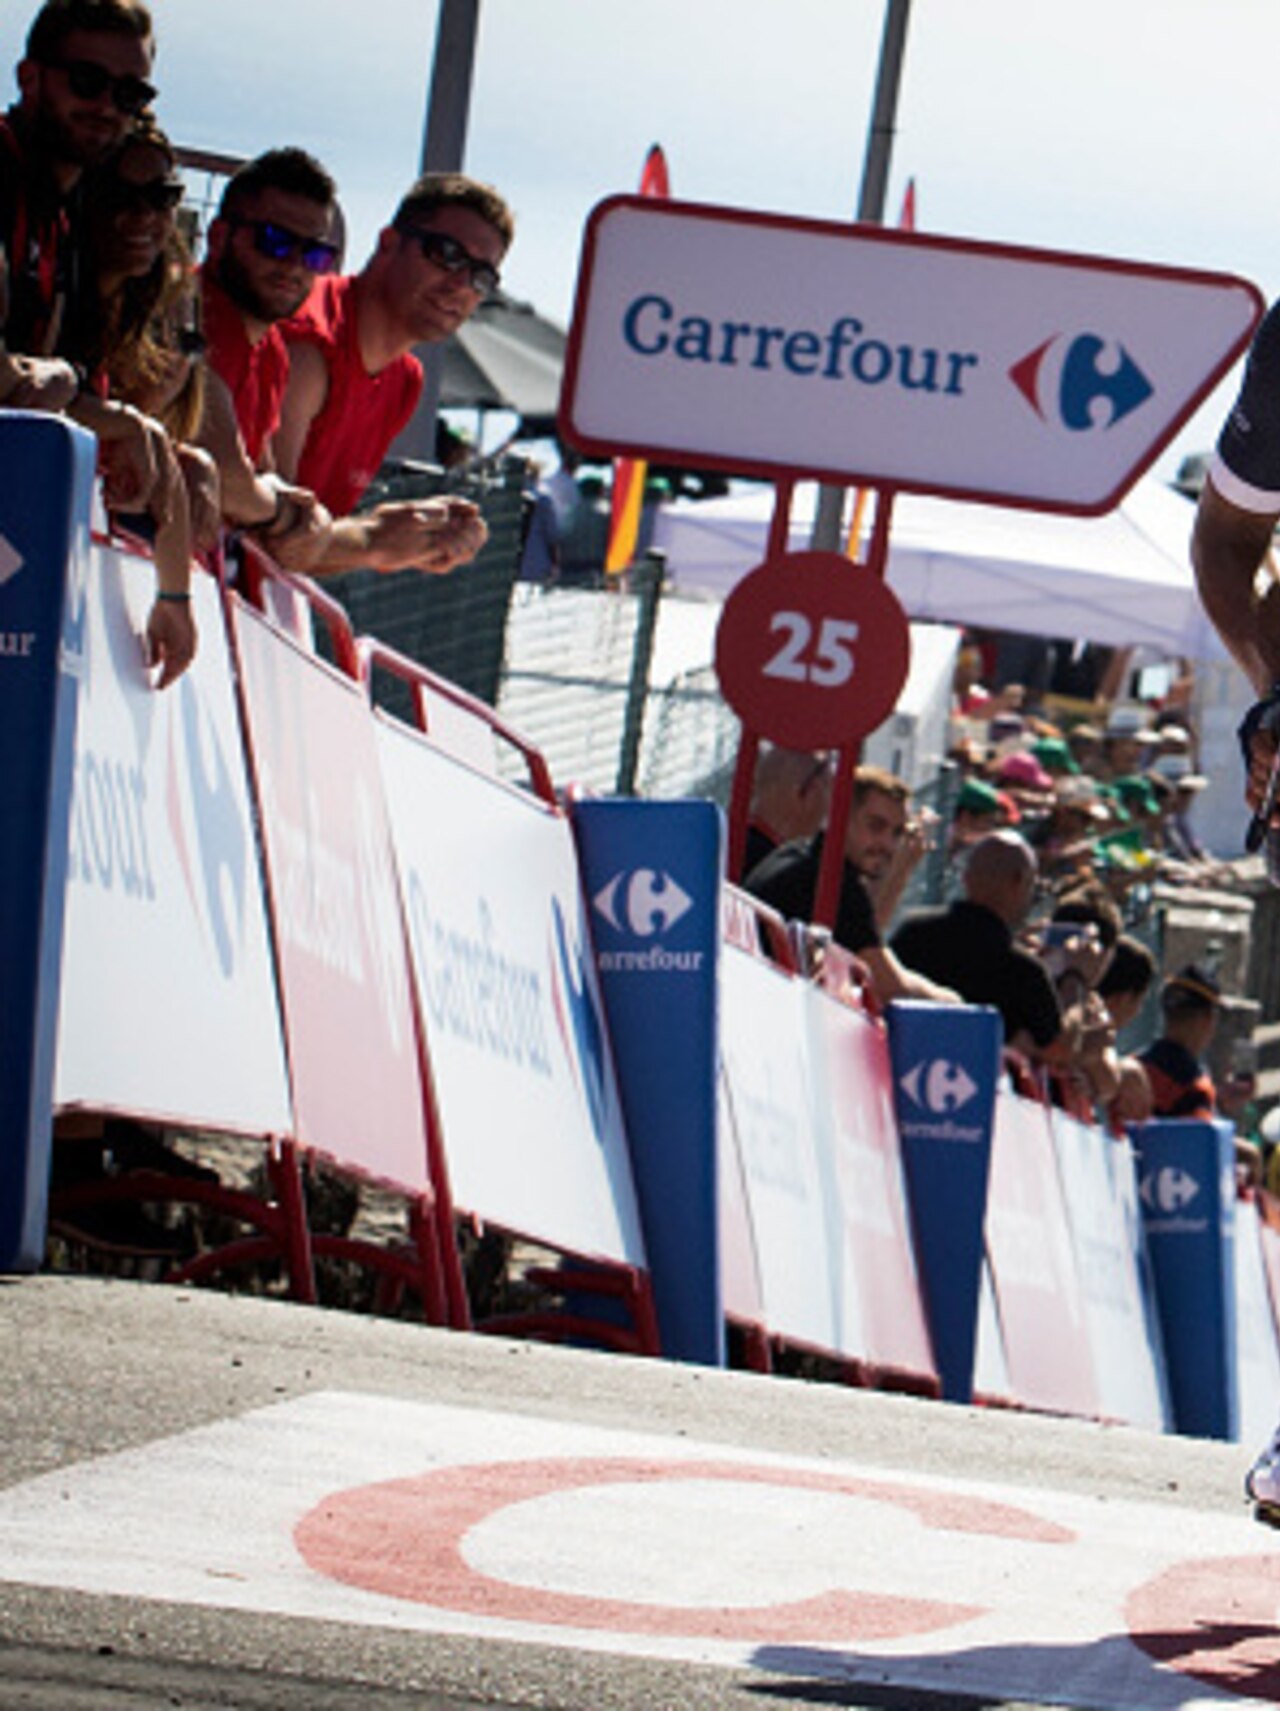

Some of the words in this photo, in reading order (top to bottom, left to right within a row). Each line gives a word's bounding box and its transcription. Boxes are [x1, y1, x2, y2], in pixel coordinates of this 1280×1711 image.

[622, 293, 979, 397] Carrefour
[761, 611, 860, 687] 25
[598, 944, 704, 972] arrefour
